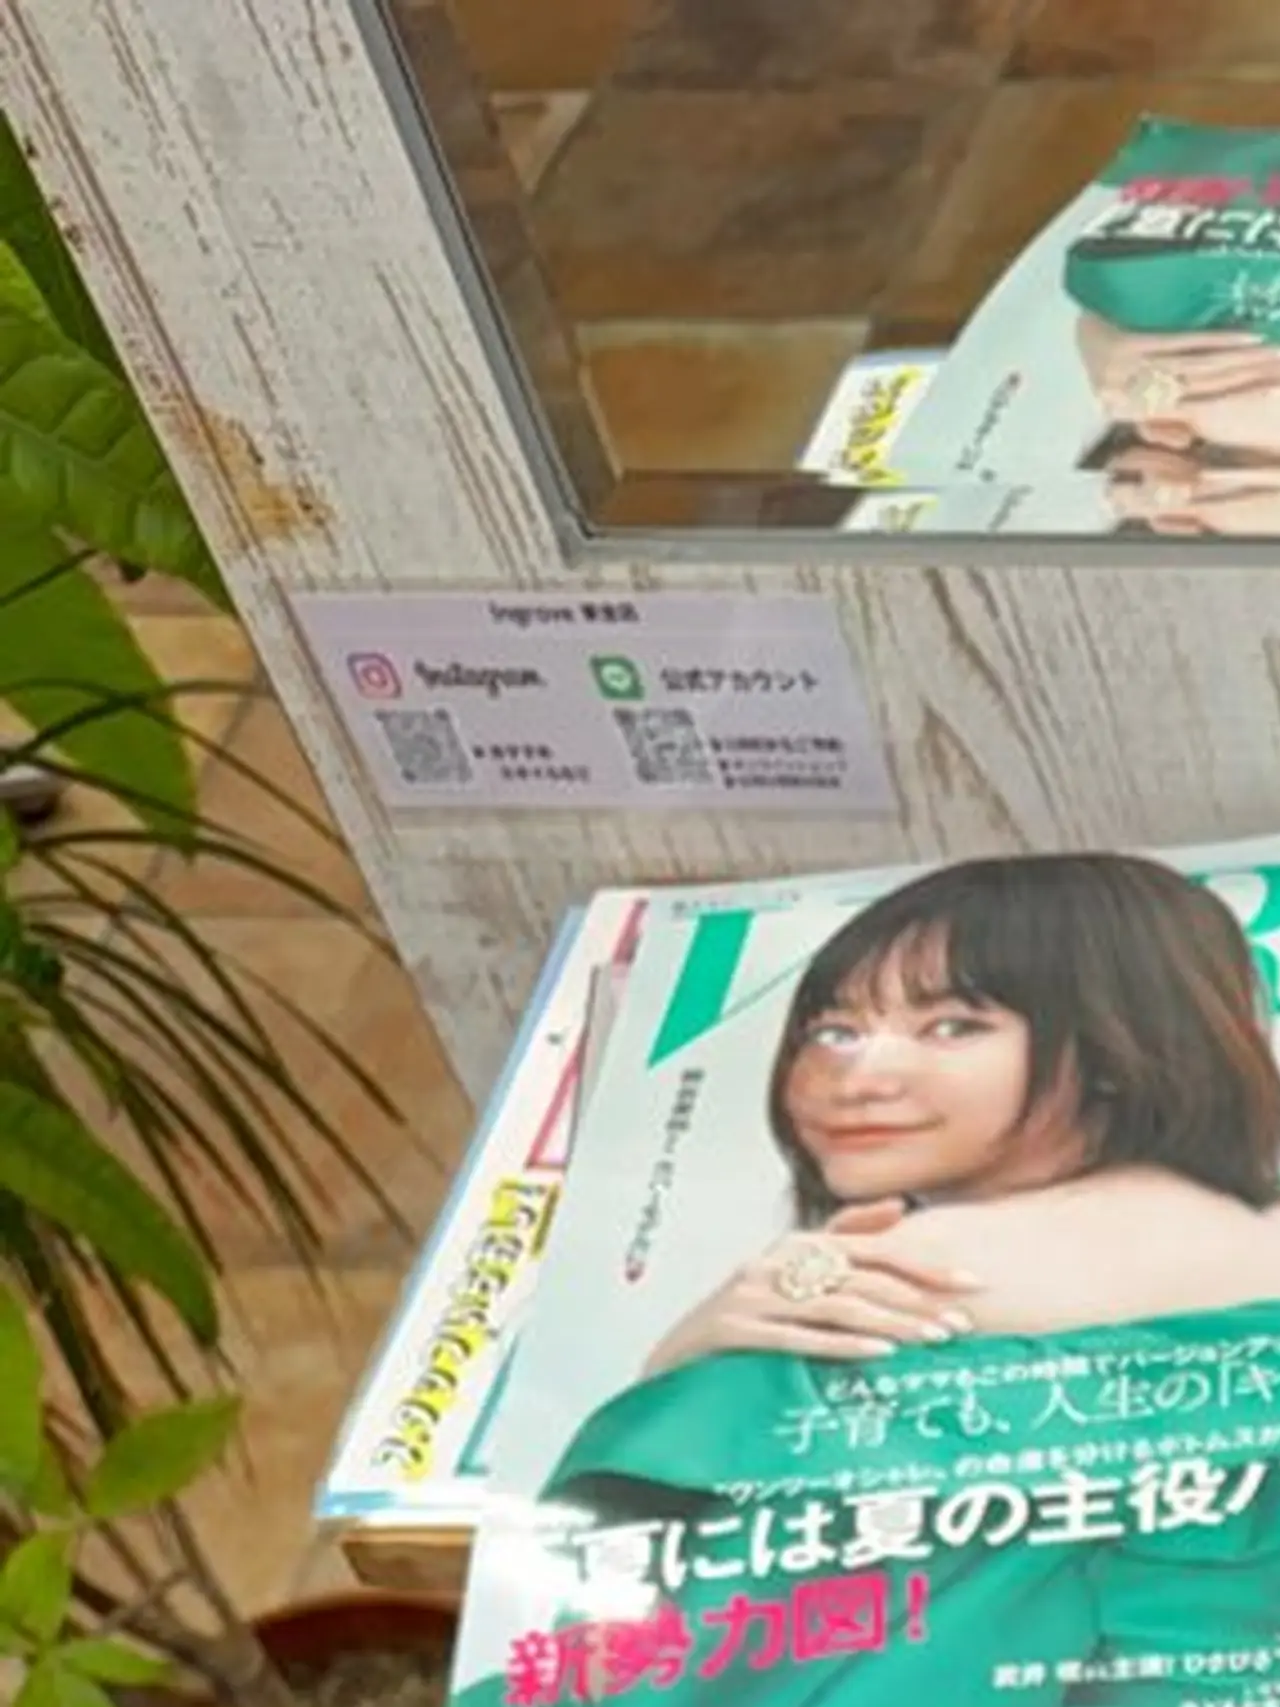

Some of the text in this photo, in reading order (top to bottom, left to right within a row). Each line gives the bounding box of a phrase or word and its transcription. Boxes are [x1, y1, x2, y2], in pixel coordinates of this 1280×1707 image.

[660, 667, 819, 693] 公式アカウント
